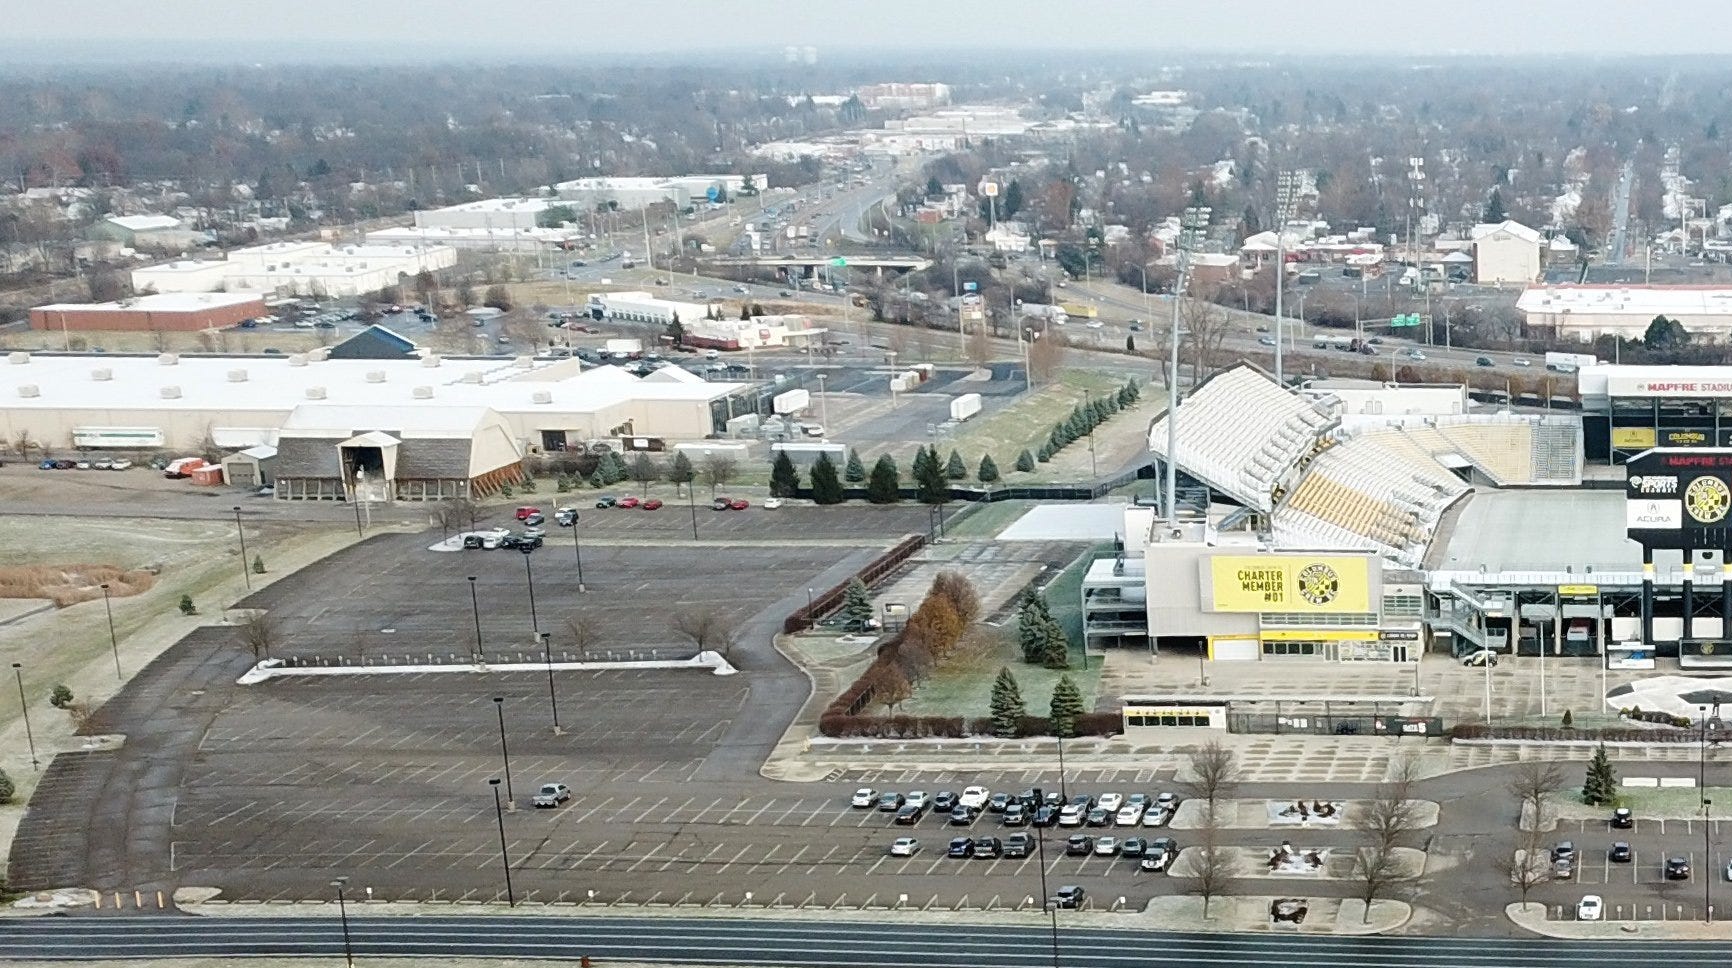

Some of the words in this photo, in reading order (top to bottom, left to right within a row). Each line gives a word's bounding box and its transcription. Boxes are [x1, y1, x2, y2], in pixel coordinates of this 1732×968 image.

[1647, 383, 1698, 392] MAPFRE
[1636, 515, 1672, 523] ACURA
[1237, 570, 1284, 581] CHARTER
[1242, 582, 1284, 592] MEMBER
[1264, 592, 1284, 603] #01
